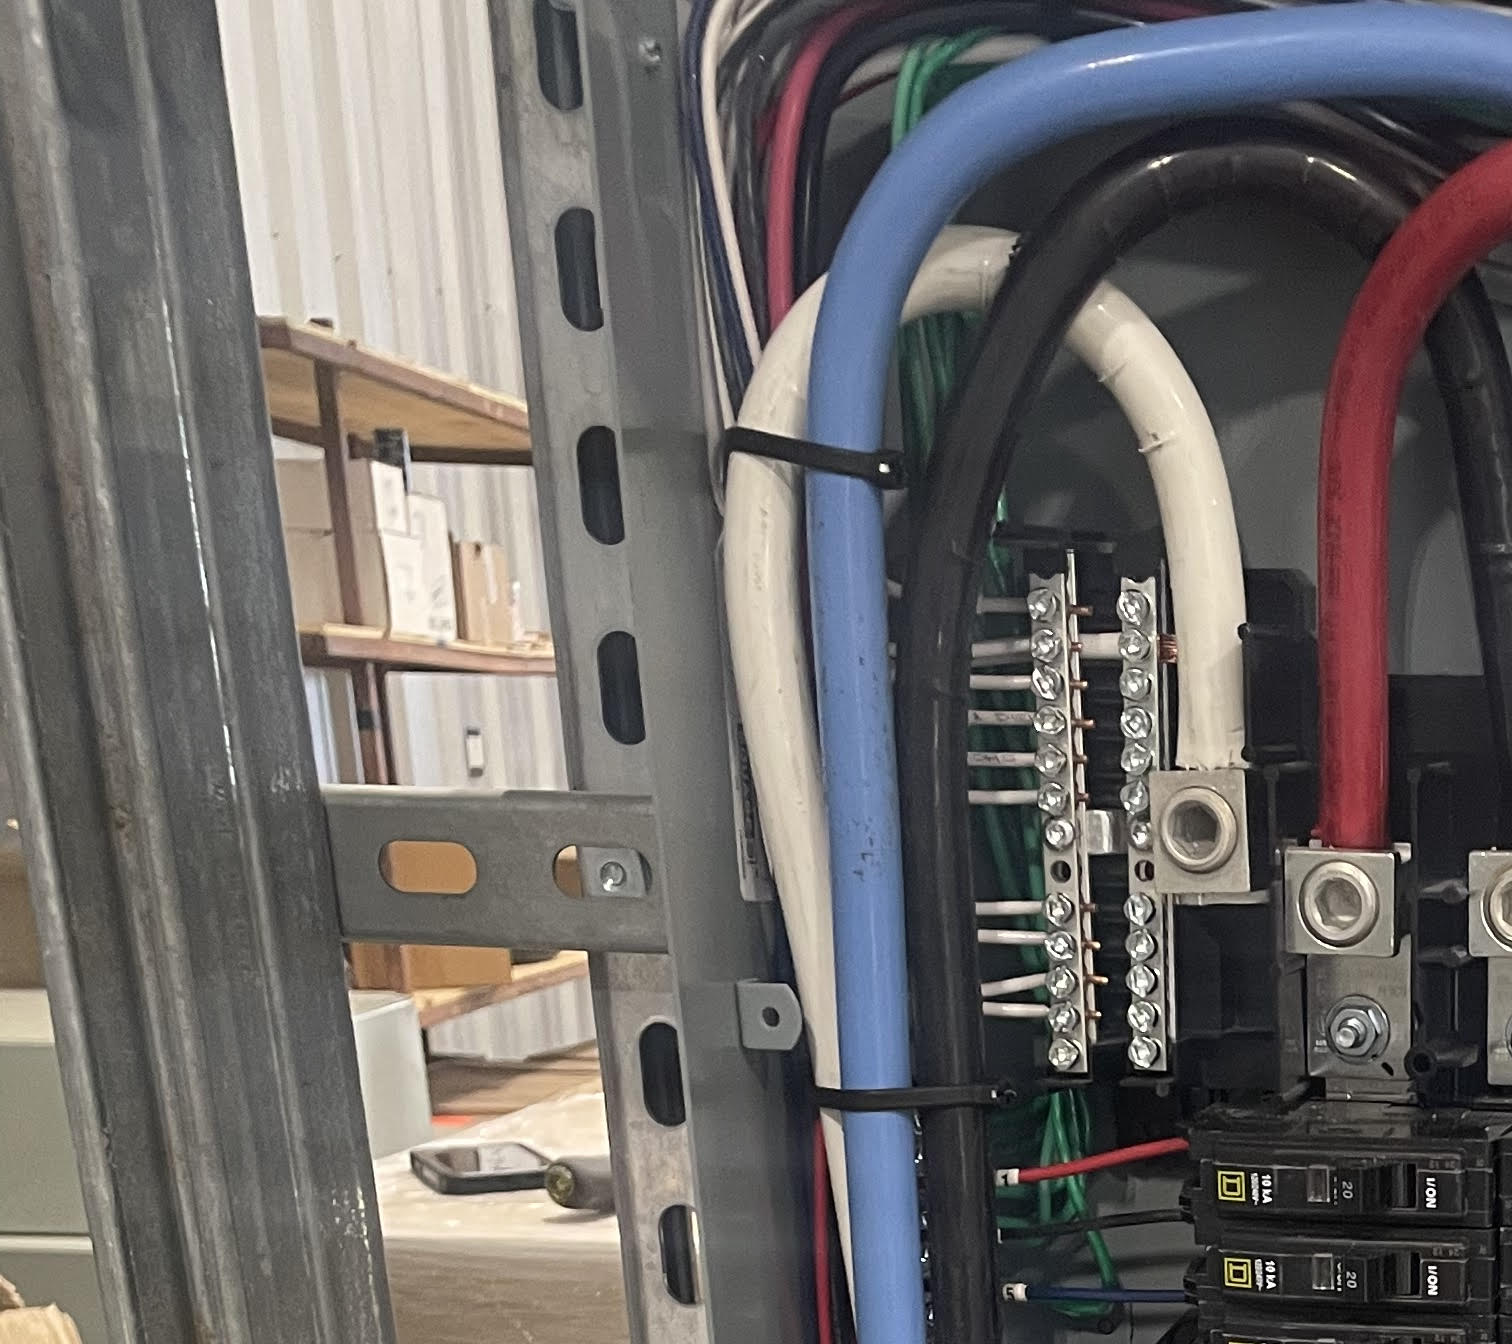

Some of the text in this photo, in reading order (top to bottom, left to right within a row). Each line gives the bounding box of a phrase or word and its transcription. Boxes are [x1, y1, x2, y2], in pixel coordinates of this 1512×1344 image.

[1001, 1173, 1009, 1186] 1
[1343, 1181, 1353, 1198] 20
[1347, 1272, 1357, 1288] 20
